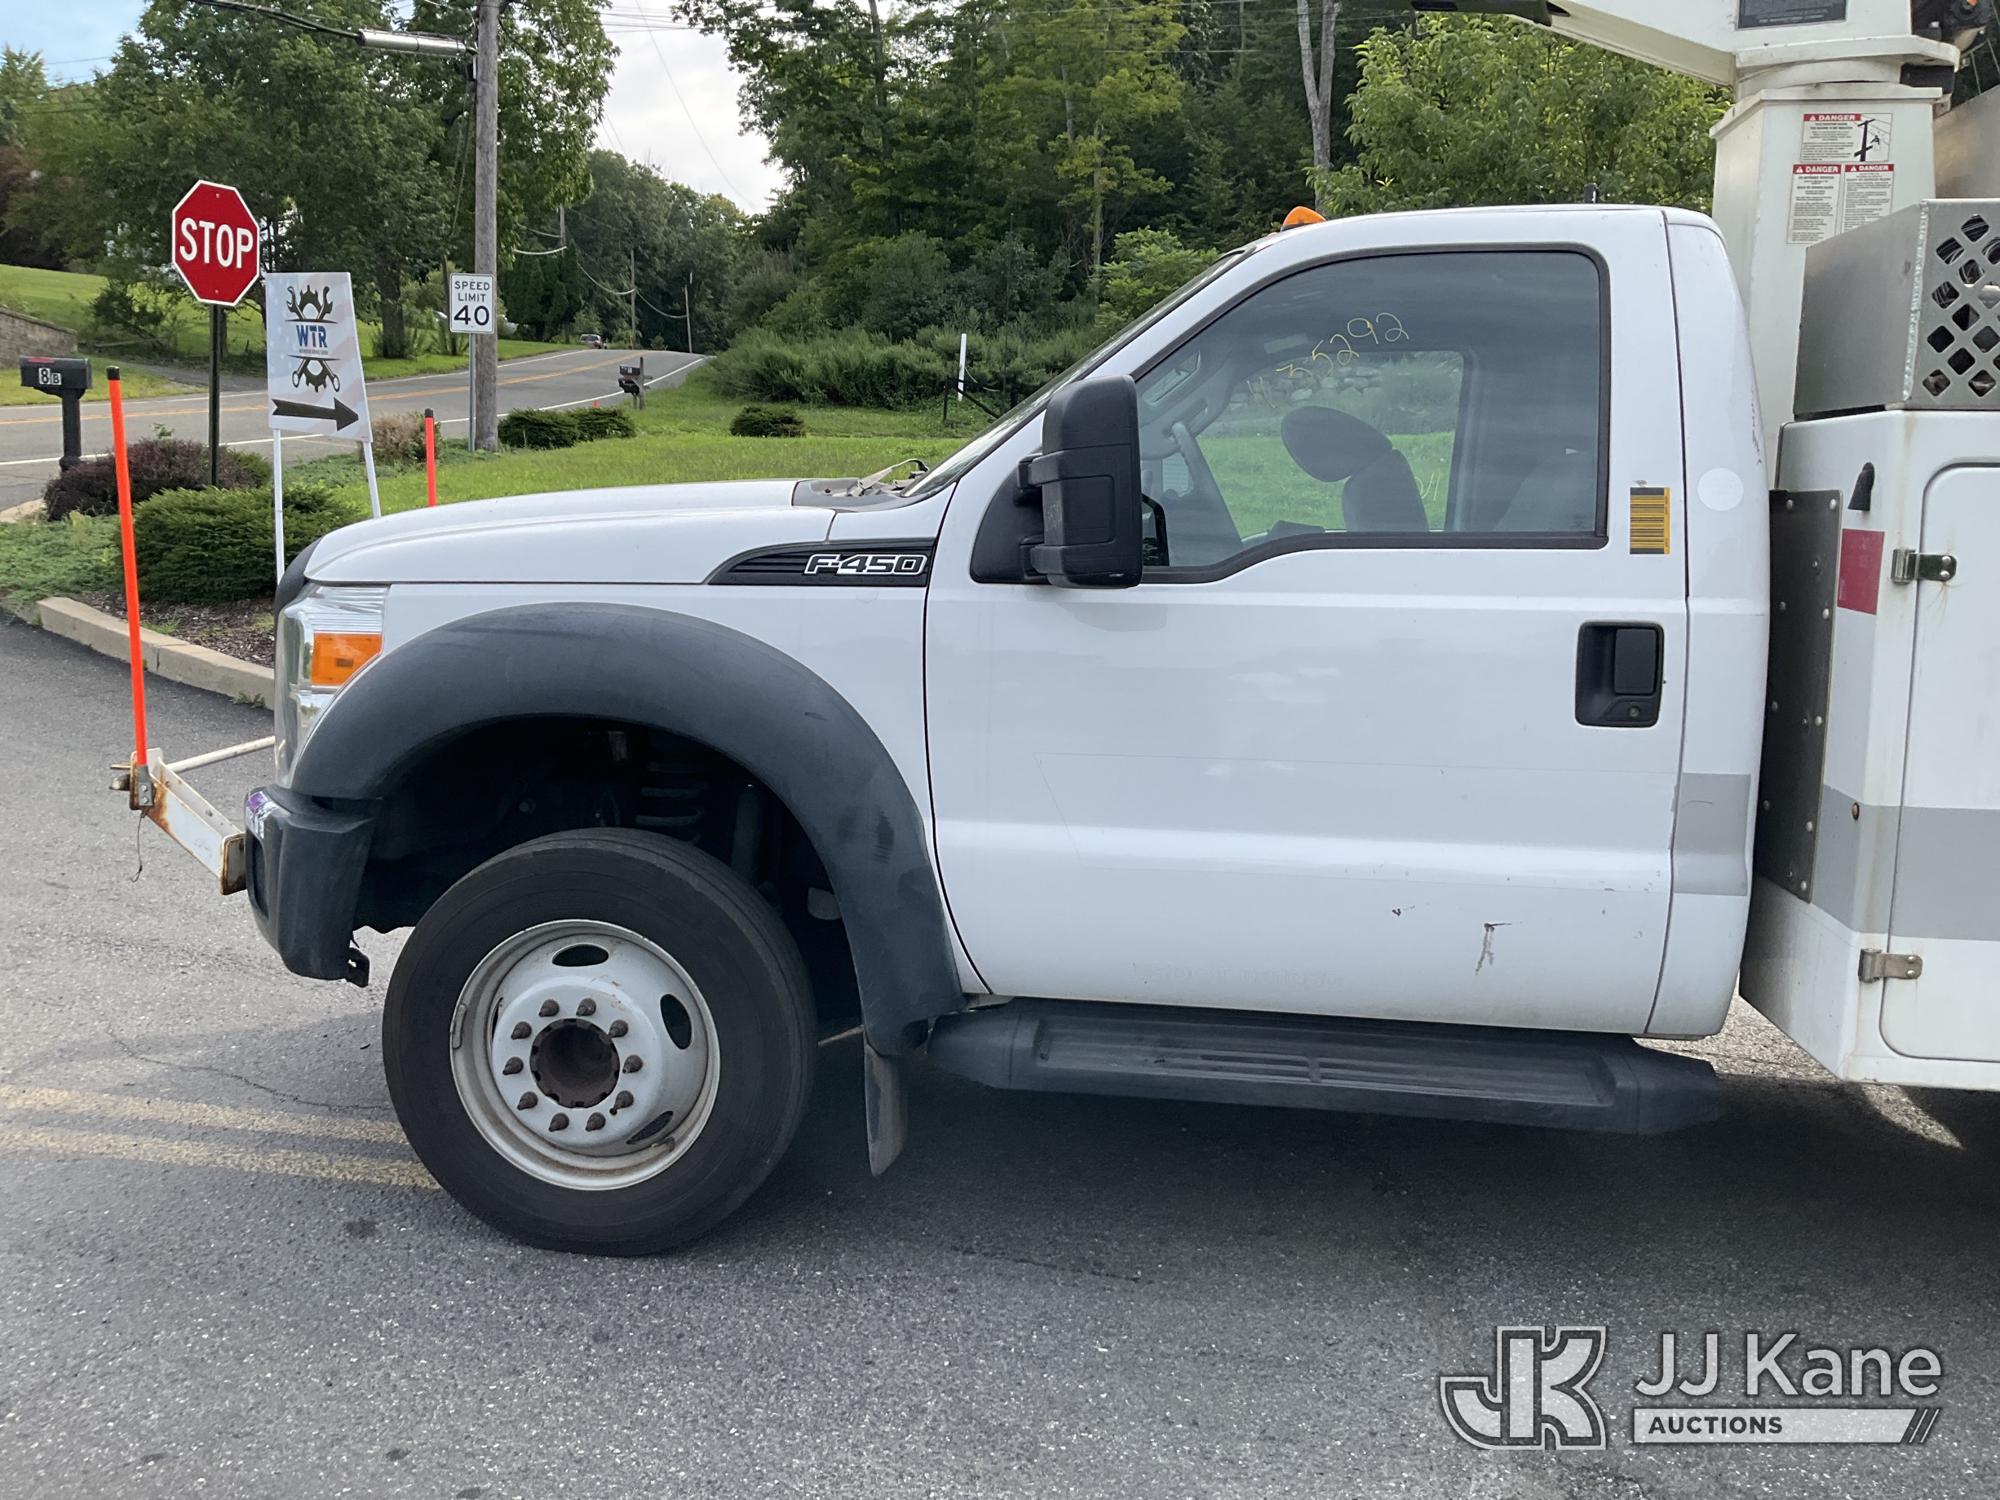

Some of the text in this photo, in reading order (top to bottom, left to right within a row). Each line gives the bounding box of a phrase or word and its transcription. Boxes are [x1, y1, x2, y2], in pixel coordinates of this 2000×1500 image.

[179, 217, 254, 269] STOP
[454, 280, 491, 291] SPEED
[457, 293, 487, 303] LIMIT
[453, 304, 490, 326] 40
[296, 324, 328, 348] WTR
[804, 553, 928, 576] F-450
